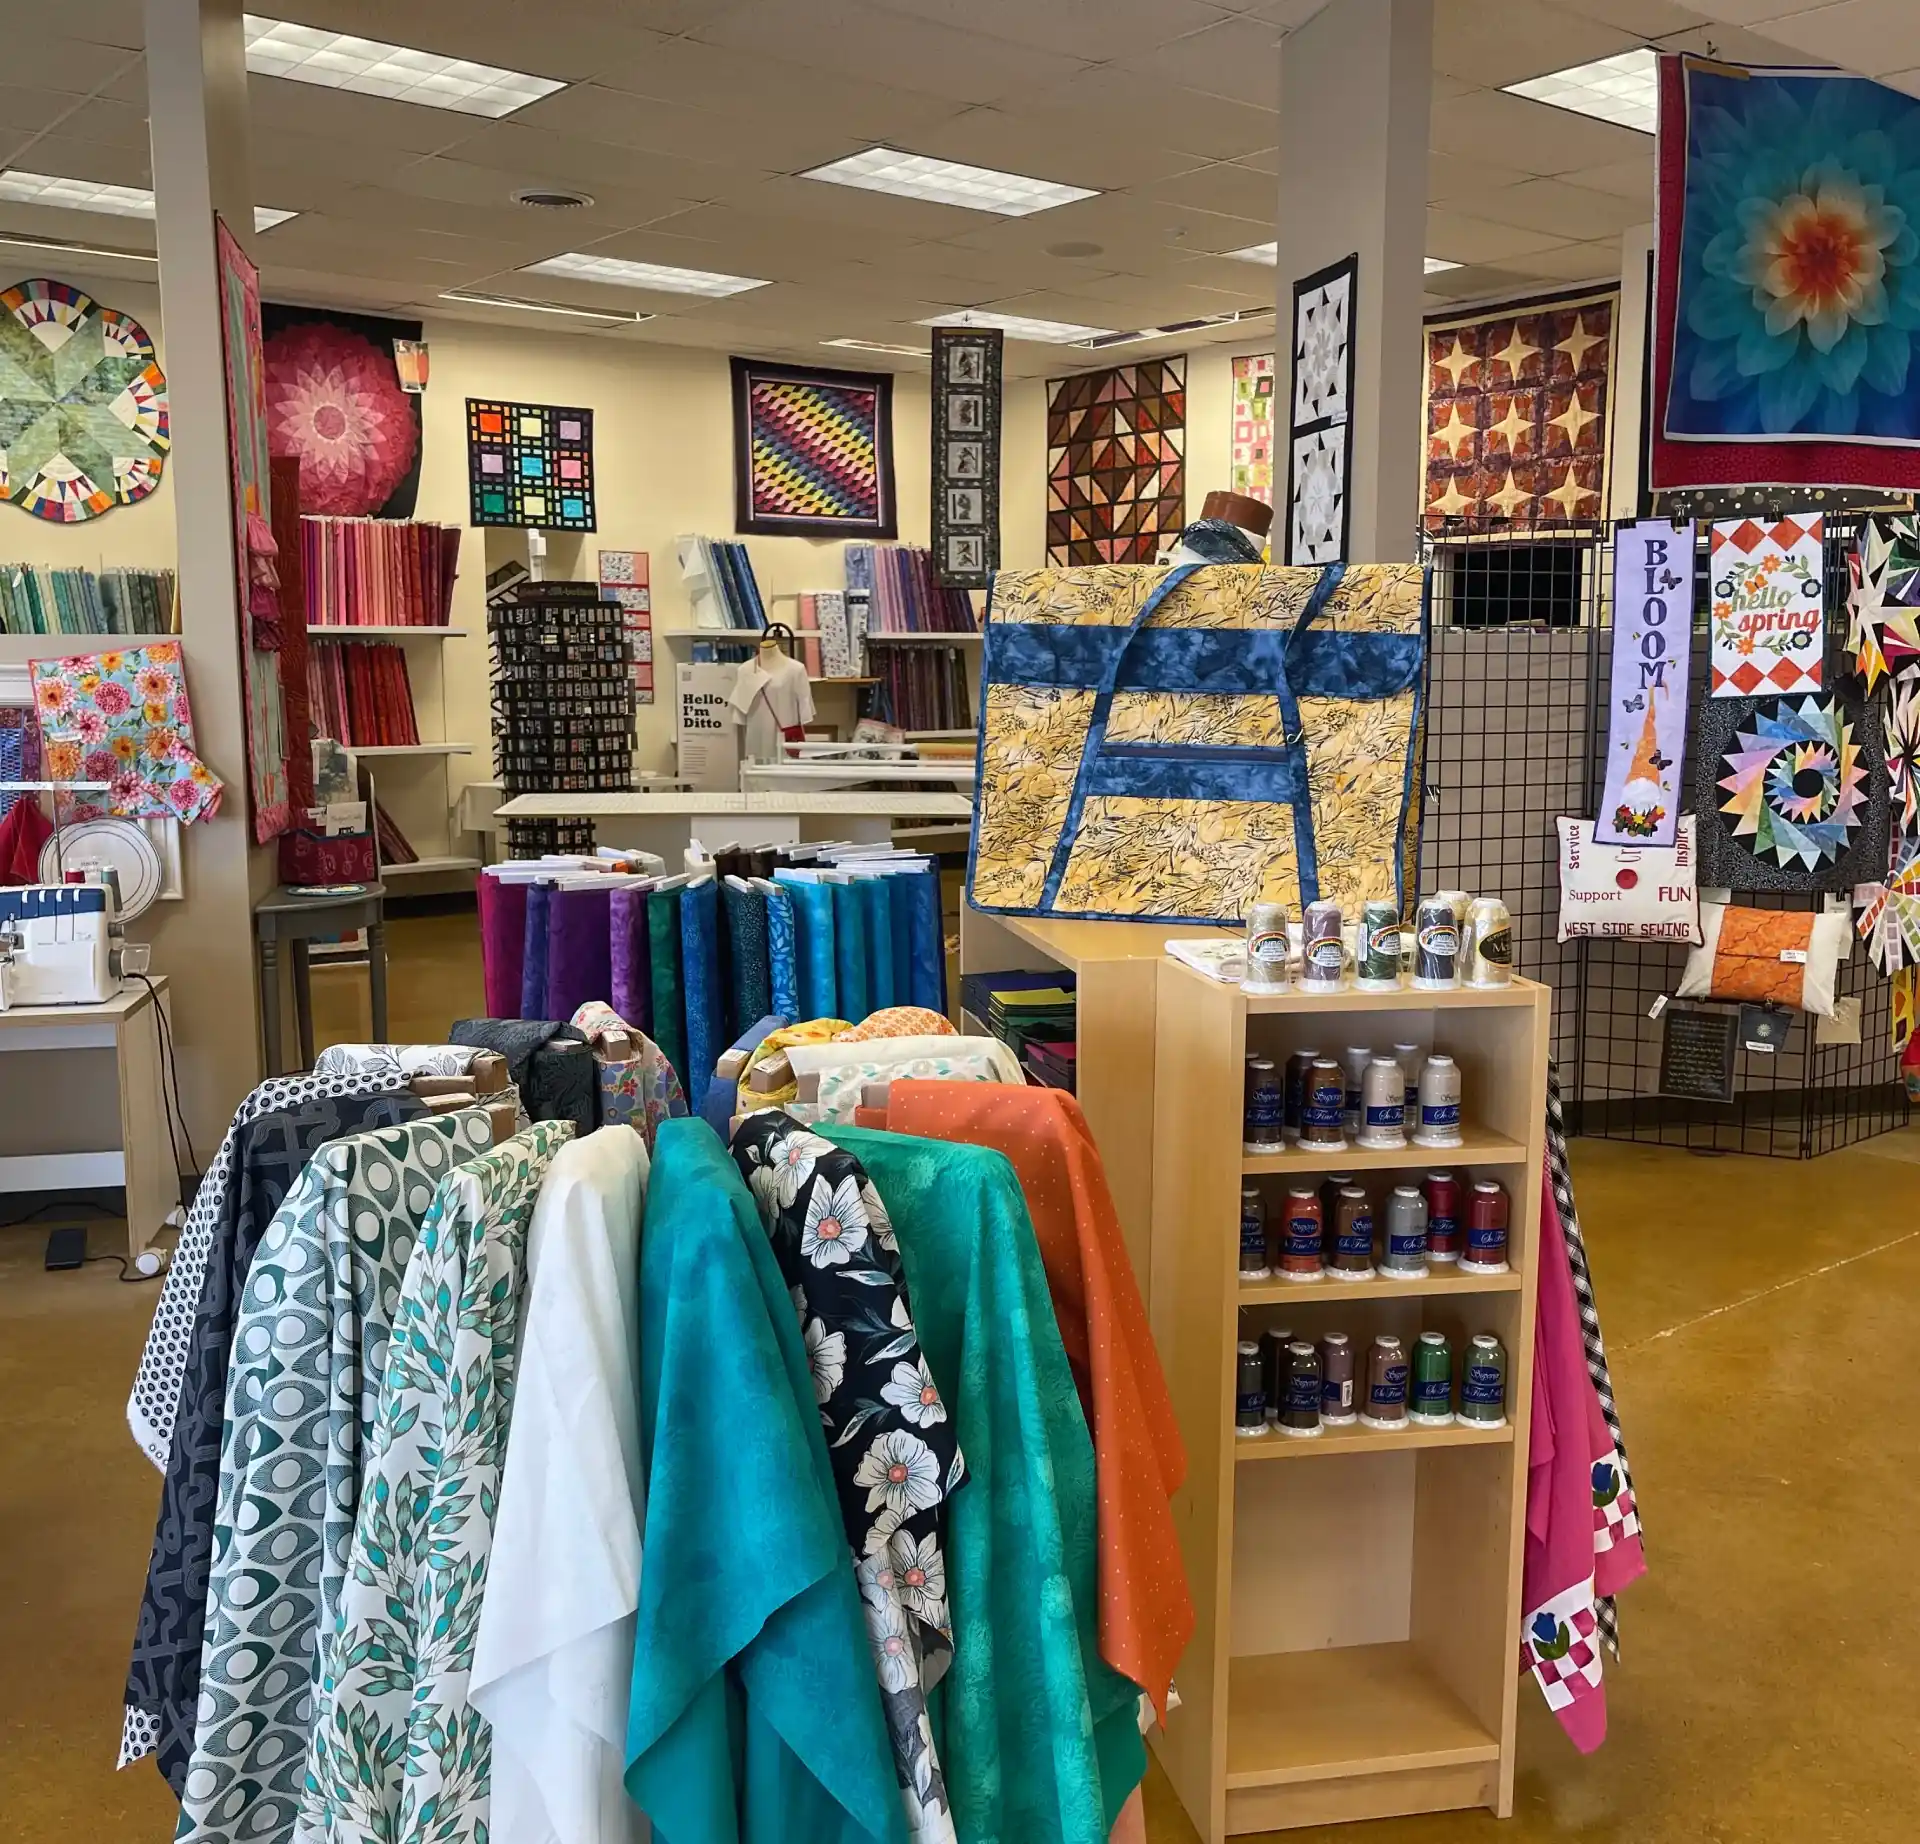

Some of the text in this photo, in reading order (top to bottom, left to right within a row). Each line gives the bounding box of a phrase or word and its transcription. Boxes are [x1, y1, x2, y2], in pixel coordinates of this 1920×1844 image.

[1732, 586, 1797, 612] hello
[1638, 539, 1668, 689] BLOOM
[1738, 608, 1822, 639] spring
[683, 694, 729, 708] Hello,
[683, 718, 722, 729] Ditto
[1566, 825, 1580, 870] Service
[1568, 890, 1623, 903] Support
[1658, 886, 1691, 902] FUN
[1564, 922, 1690, 937] WEST SIDE SEWING
